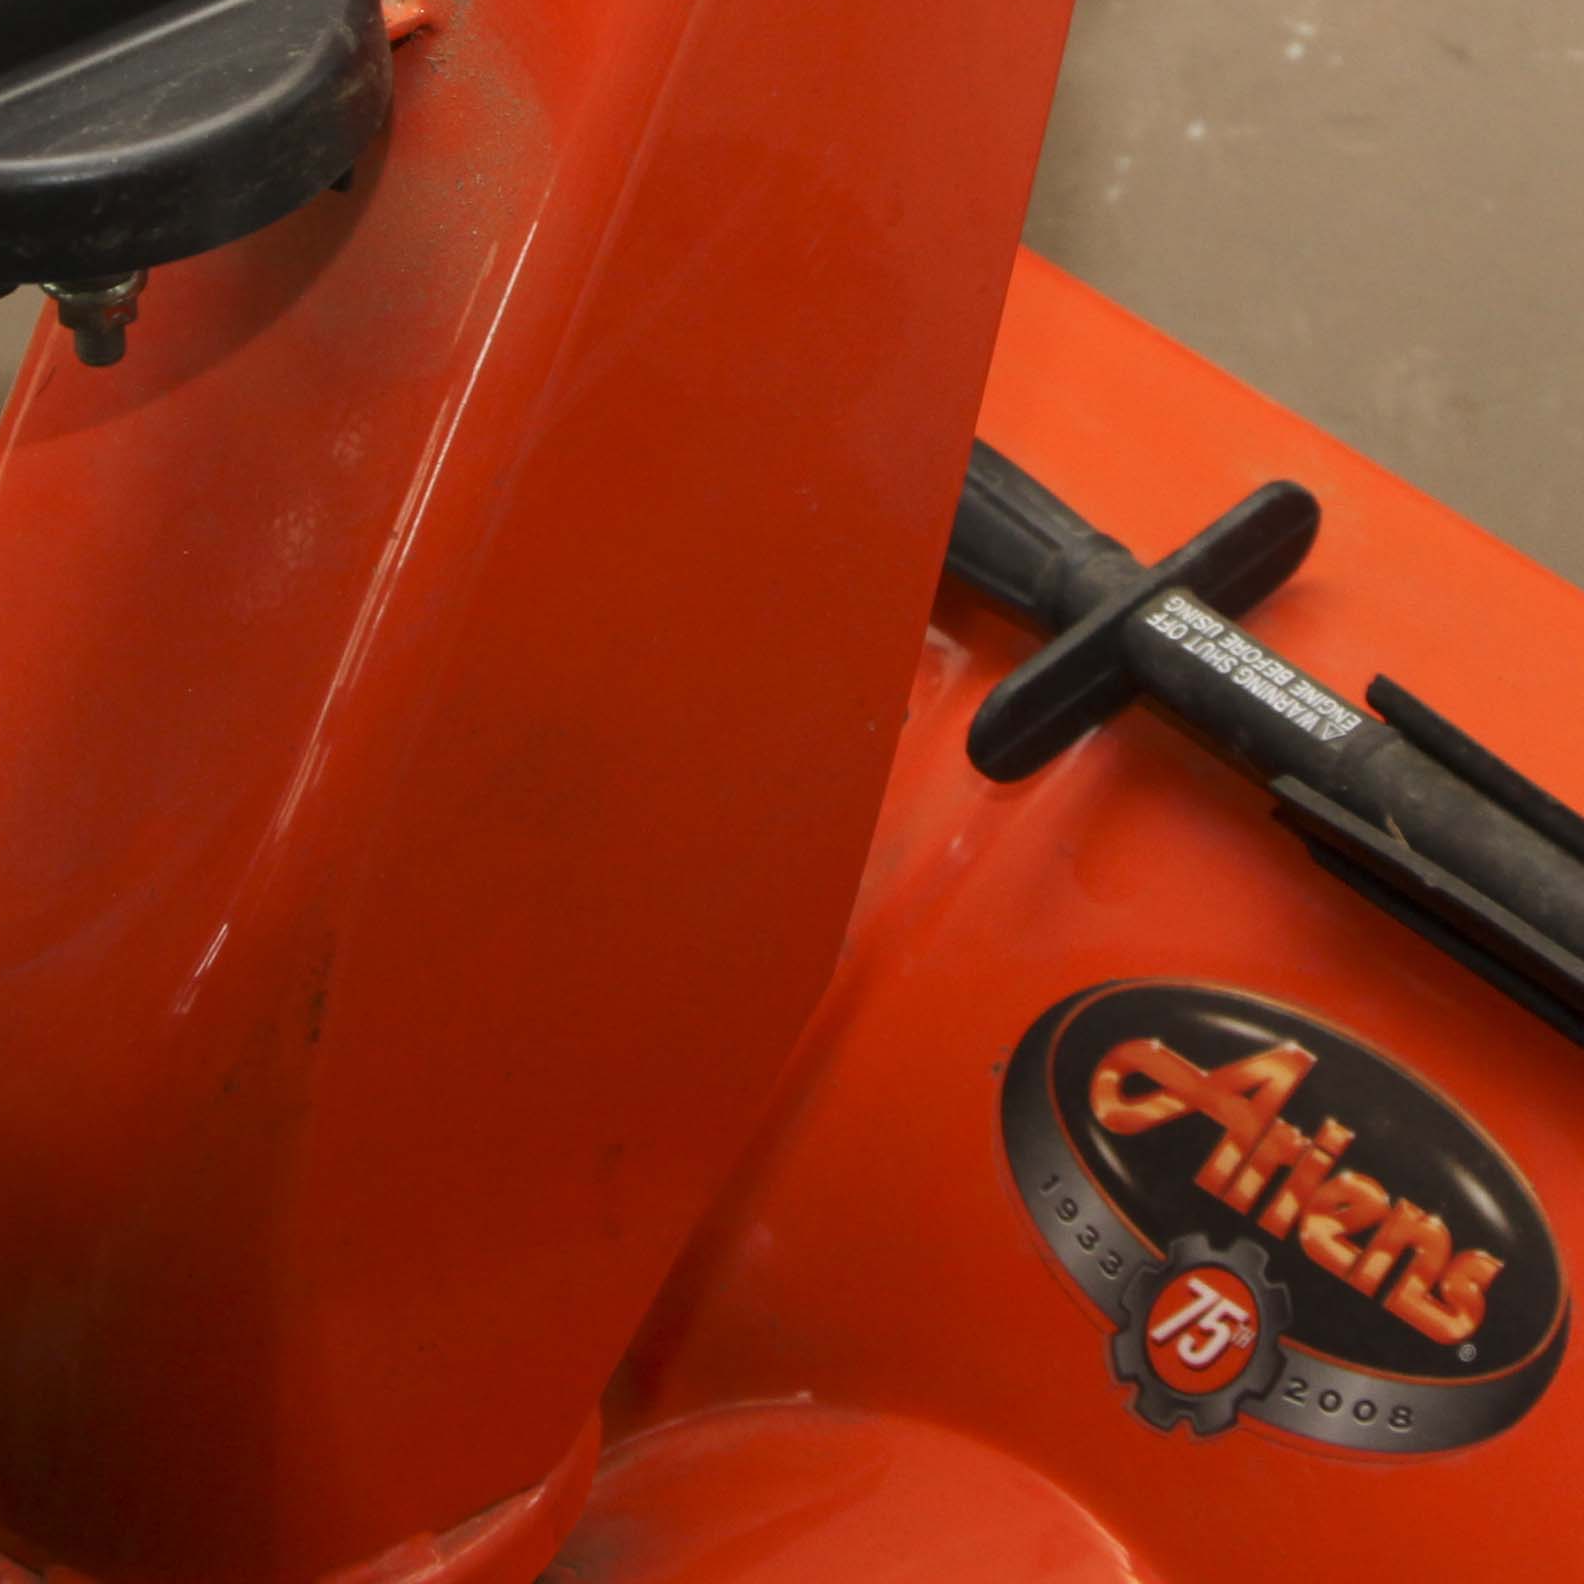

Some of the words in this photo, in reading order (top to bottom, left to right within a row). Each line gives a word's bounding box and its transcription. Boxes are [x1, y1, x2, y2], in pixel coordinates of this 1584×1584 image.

[1144, 609, 1190, 641] OFF
[1162, 594, 1226, 639] USING
[1181, 634, 1240, 674] SHUT
[1217, 631, 1297, 686] BEFORE
[1230, 665, 1324, 732] WARNING
[1287, 678, 1364, 732] ENGINE
[1089, 1036, 1505, 1346] Ariens
[1039, 1171, 1122, 1279] 1933
[1282, 1377, 1414, 1432] 2008
